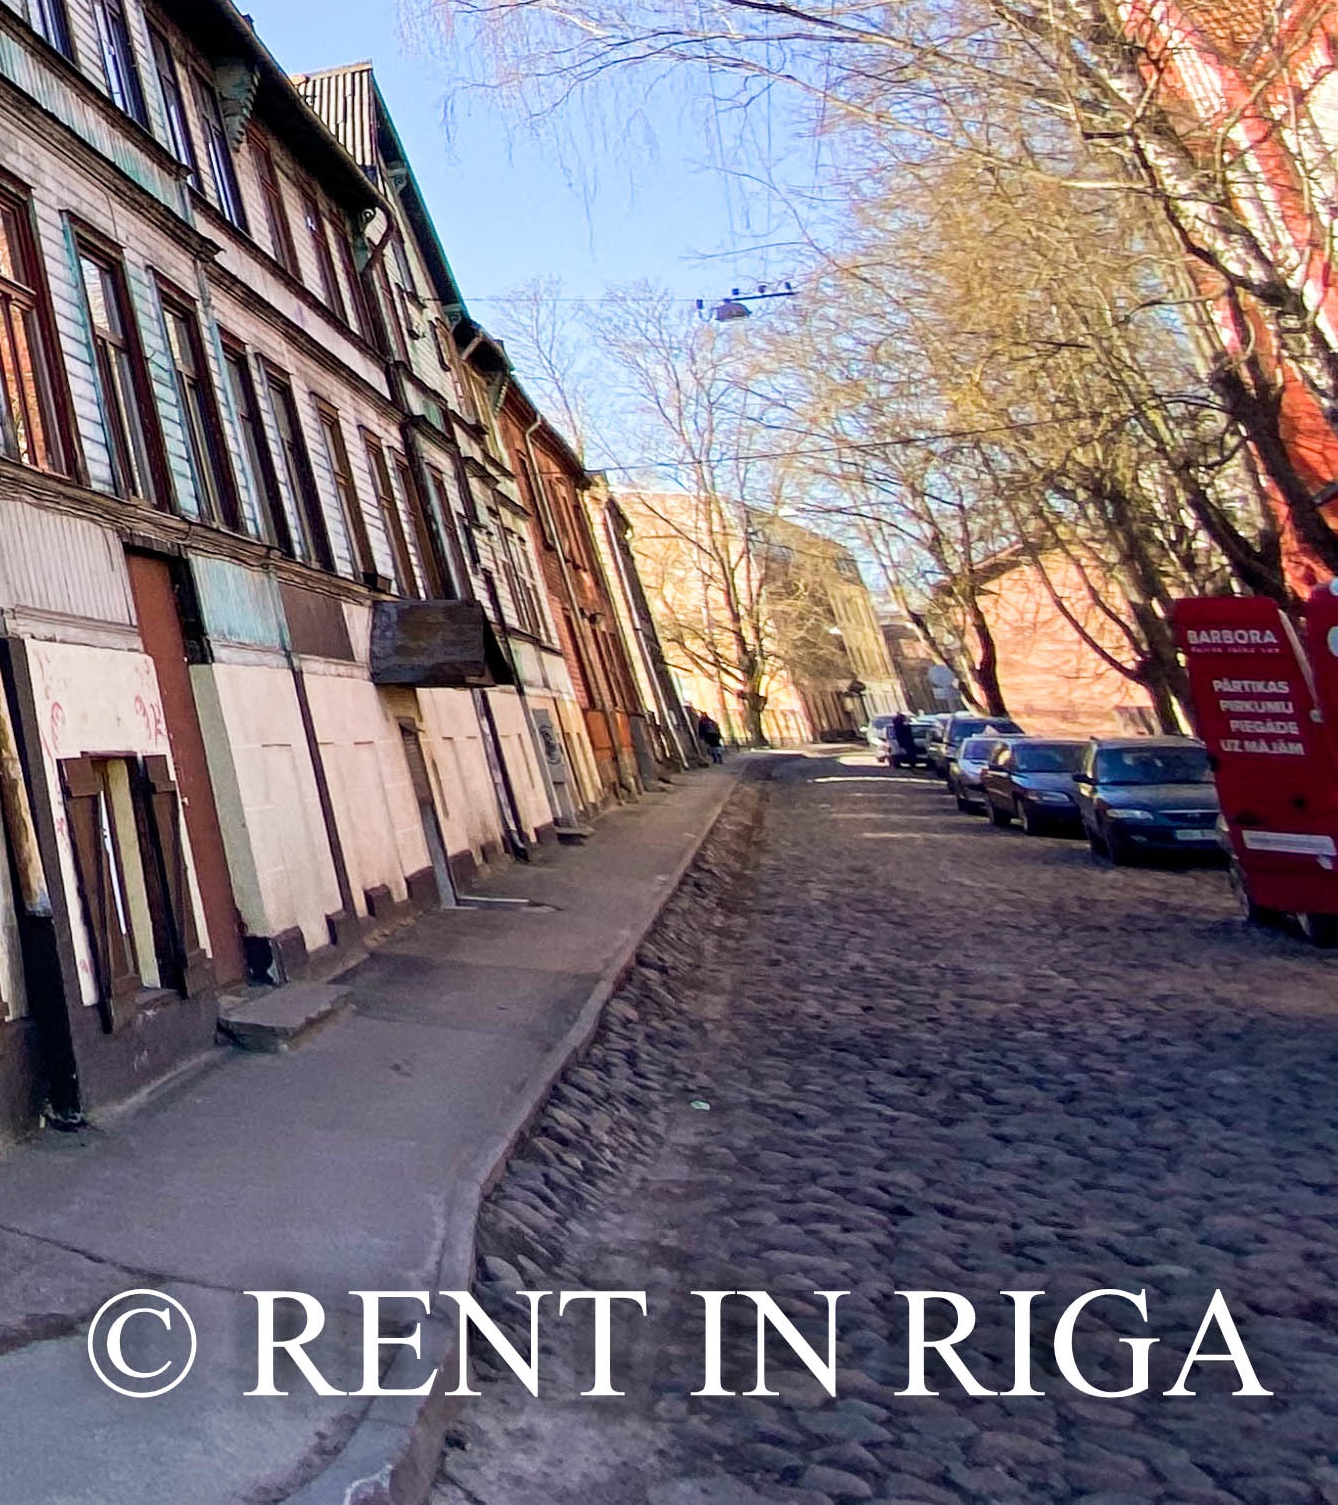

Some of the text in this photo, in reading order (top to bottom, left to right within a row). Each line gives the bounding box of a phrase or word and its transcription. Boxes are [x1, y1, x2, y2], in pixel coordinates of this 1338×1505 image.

[1187, 630, 1277, 644] BARBORA
[1219, 700, 1294, 713] PIRKUMU
[1220, 739, 1243, 752] UZ
